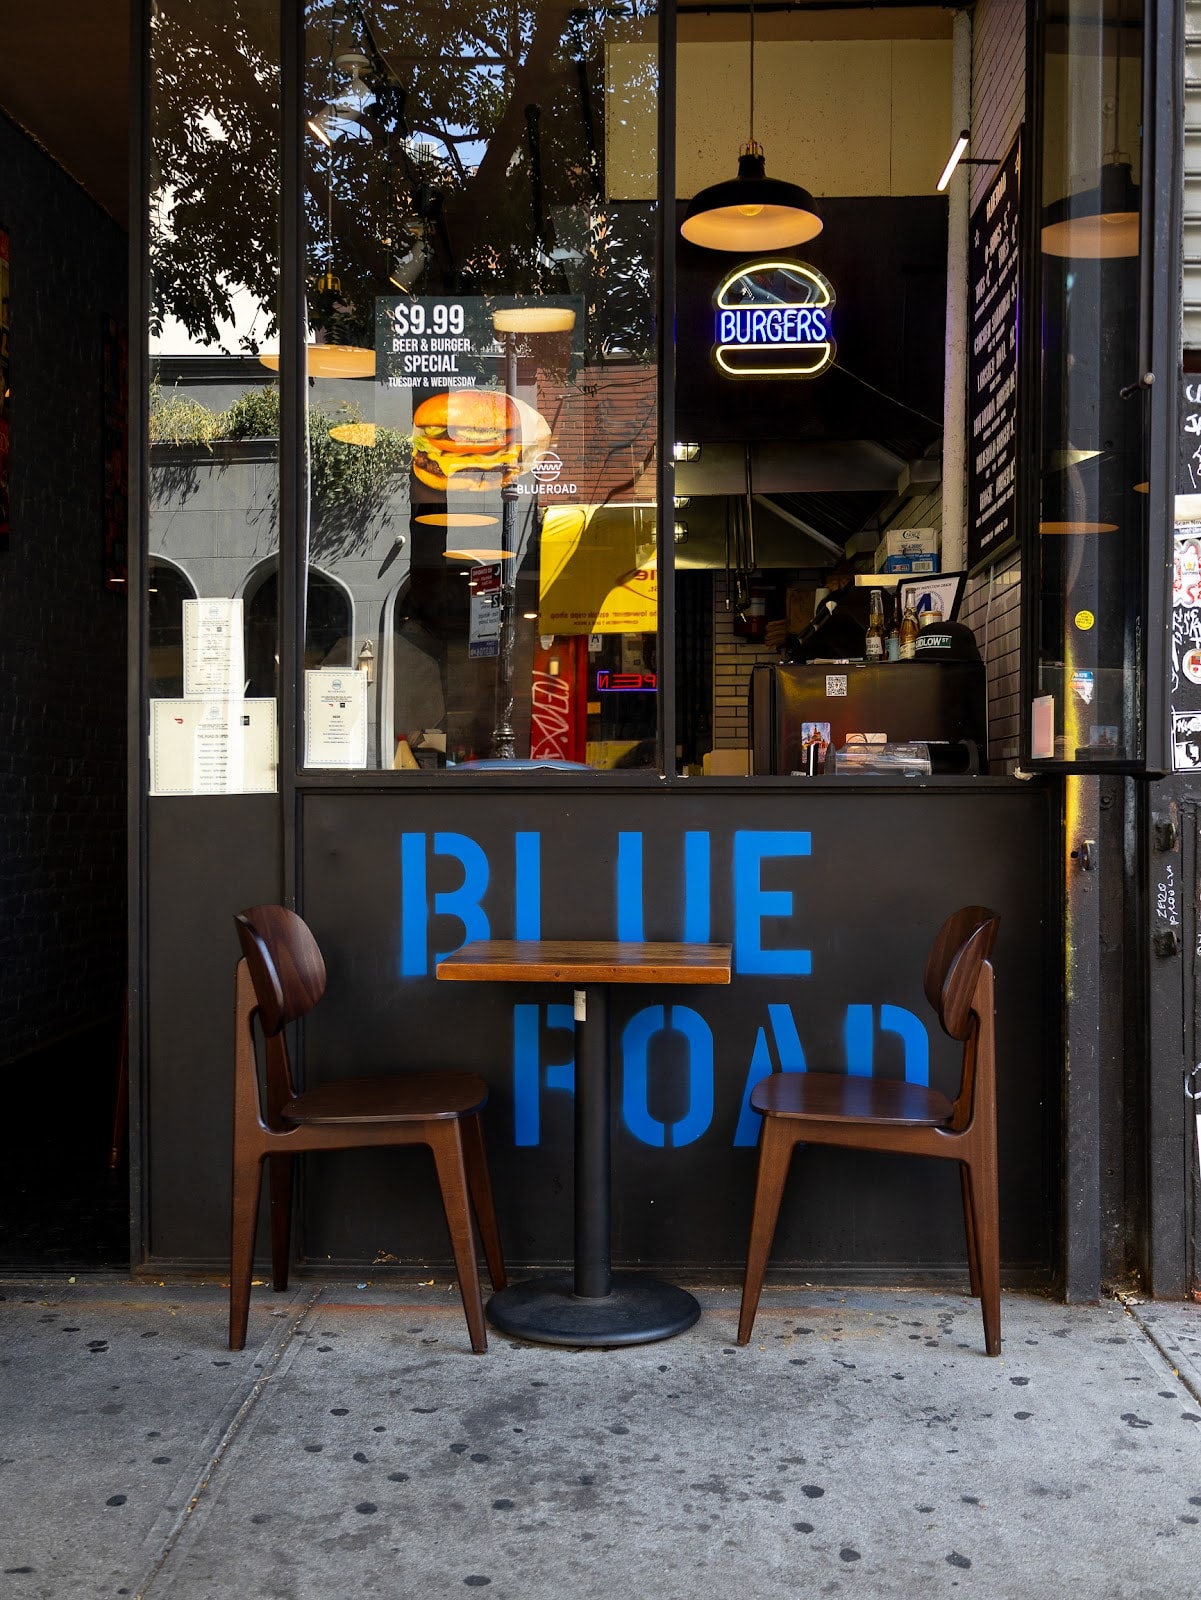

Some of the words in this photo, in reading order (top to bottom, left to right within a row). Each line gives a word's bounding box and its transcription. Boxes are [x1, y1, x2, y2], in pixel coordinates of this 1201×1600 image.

[394, 303, 465, 336] $9.99
[721, 309, 826, 343] BURGERS
[392, 338, 418, 352] BEER
[420, 339, 429, 352] &
[430, 338, 471, 352] BURGER
[404, 354, 459, 373] SPECIAL
[388, 376, 422, 388] TUESDAY
[422, 377, 430, 388] &
[430, 376, 477, 388] WEDNESDAY
[517, 483, 577, 495] BLUEROAD
[400, 831, 812, 976] BLUE
